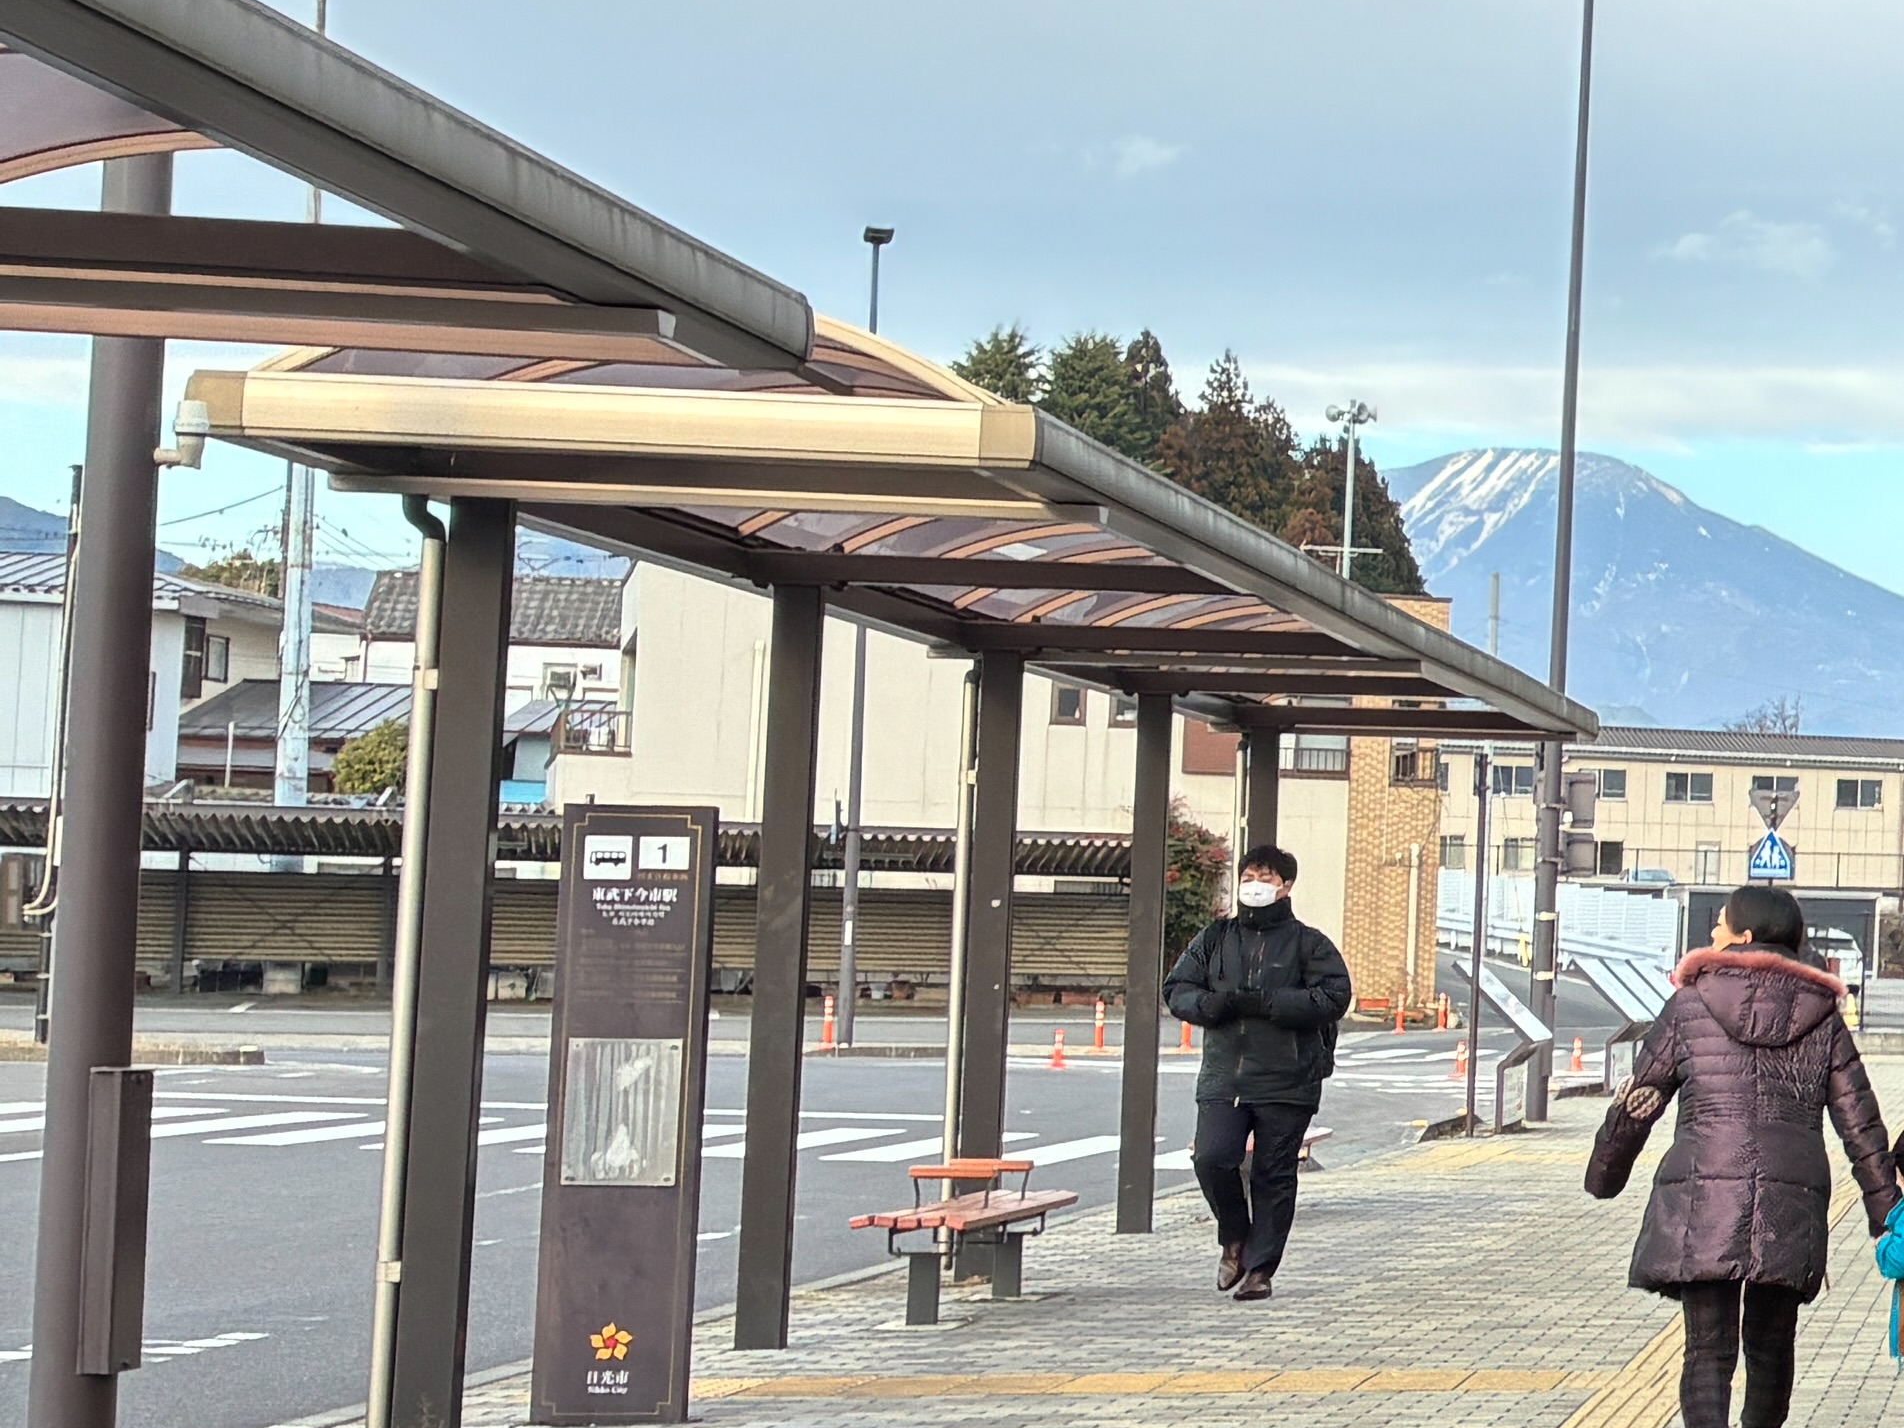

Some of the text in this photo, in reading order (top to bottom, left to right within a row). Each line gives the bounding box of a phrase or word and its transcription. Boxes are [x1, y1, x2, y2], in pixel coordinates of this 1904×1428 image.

[657, 843, 668, 864] 1
[587, 1370, 629, 1384] 日光市
